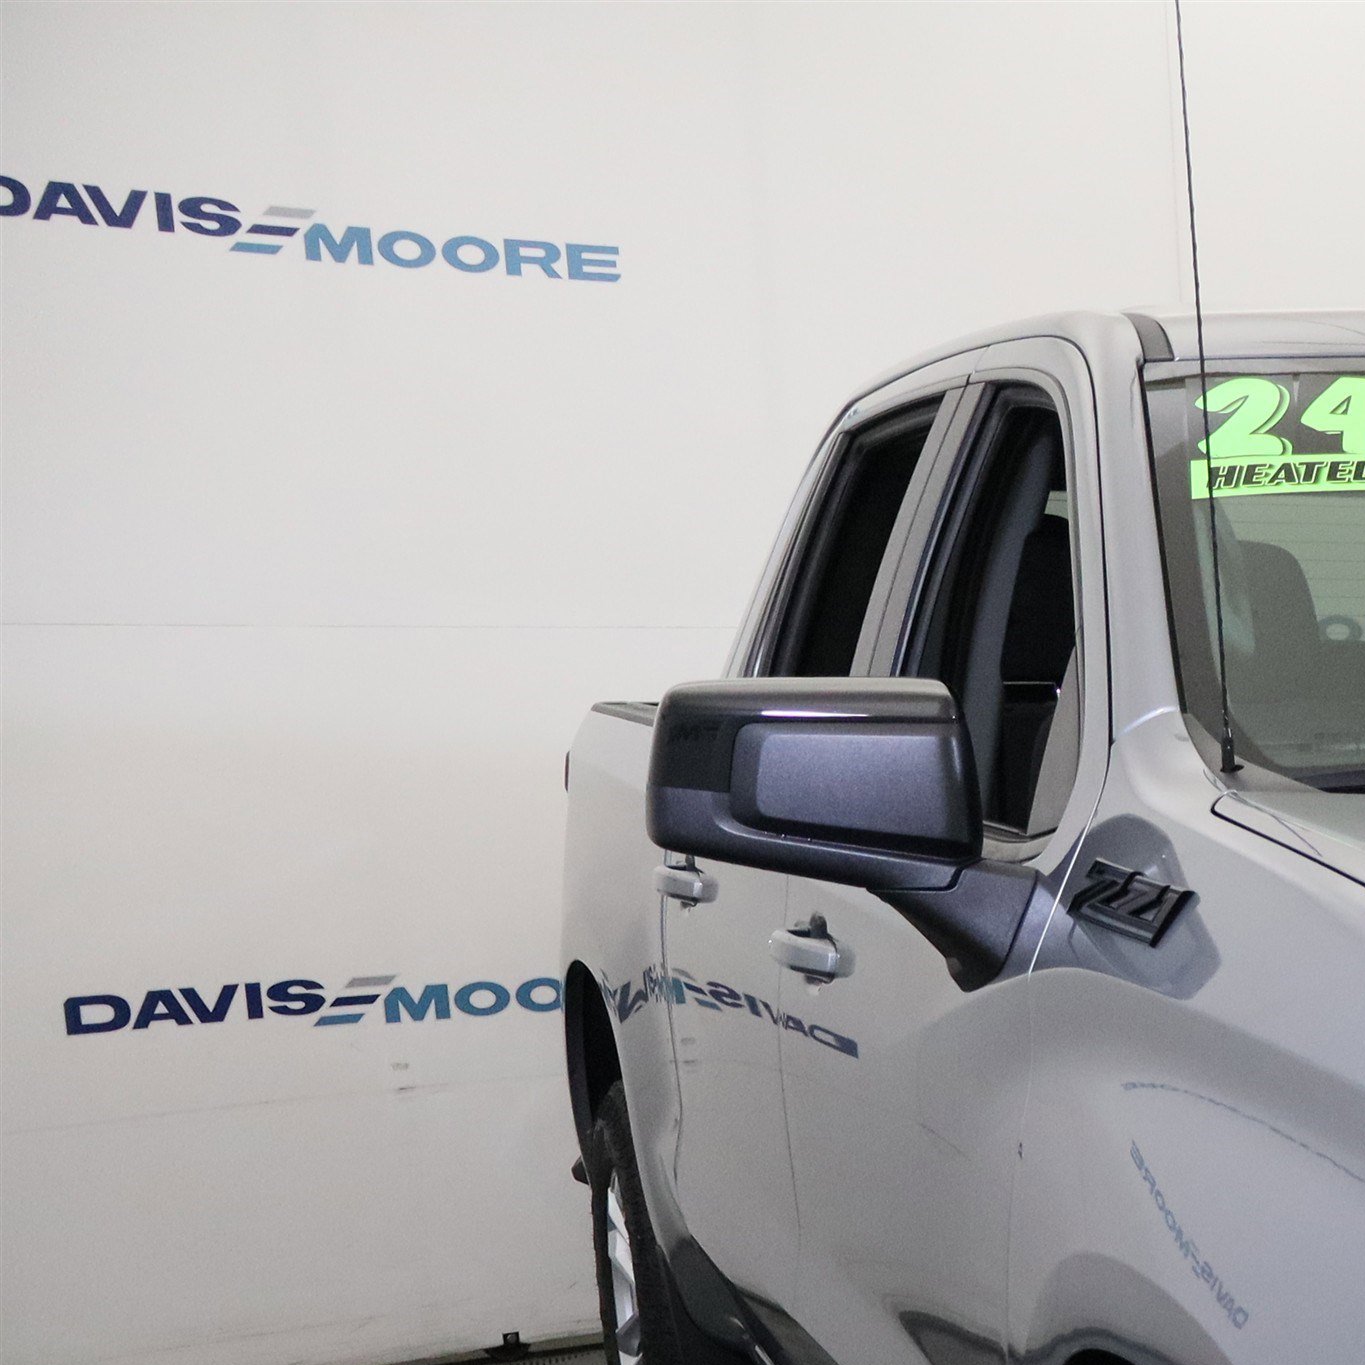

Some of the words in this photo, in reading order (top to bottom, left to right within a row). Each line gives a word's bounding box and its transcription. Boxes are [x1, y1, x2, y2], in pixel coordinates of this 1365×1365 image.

[303, 222, 622, 283] MOORE
[1066, 857, 1200, 949] Z71
[62, 978, 326, 1036] DAVIS
[384, 976, 564, 1024] MOO
